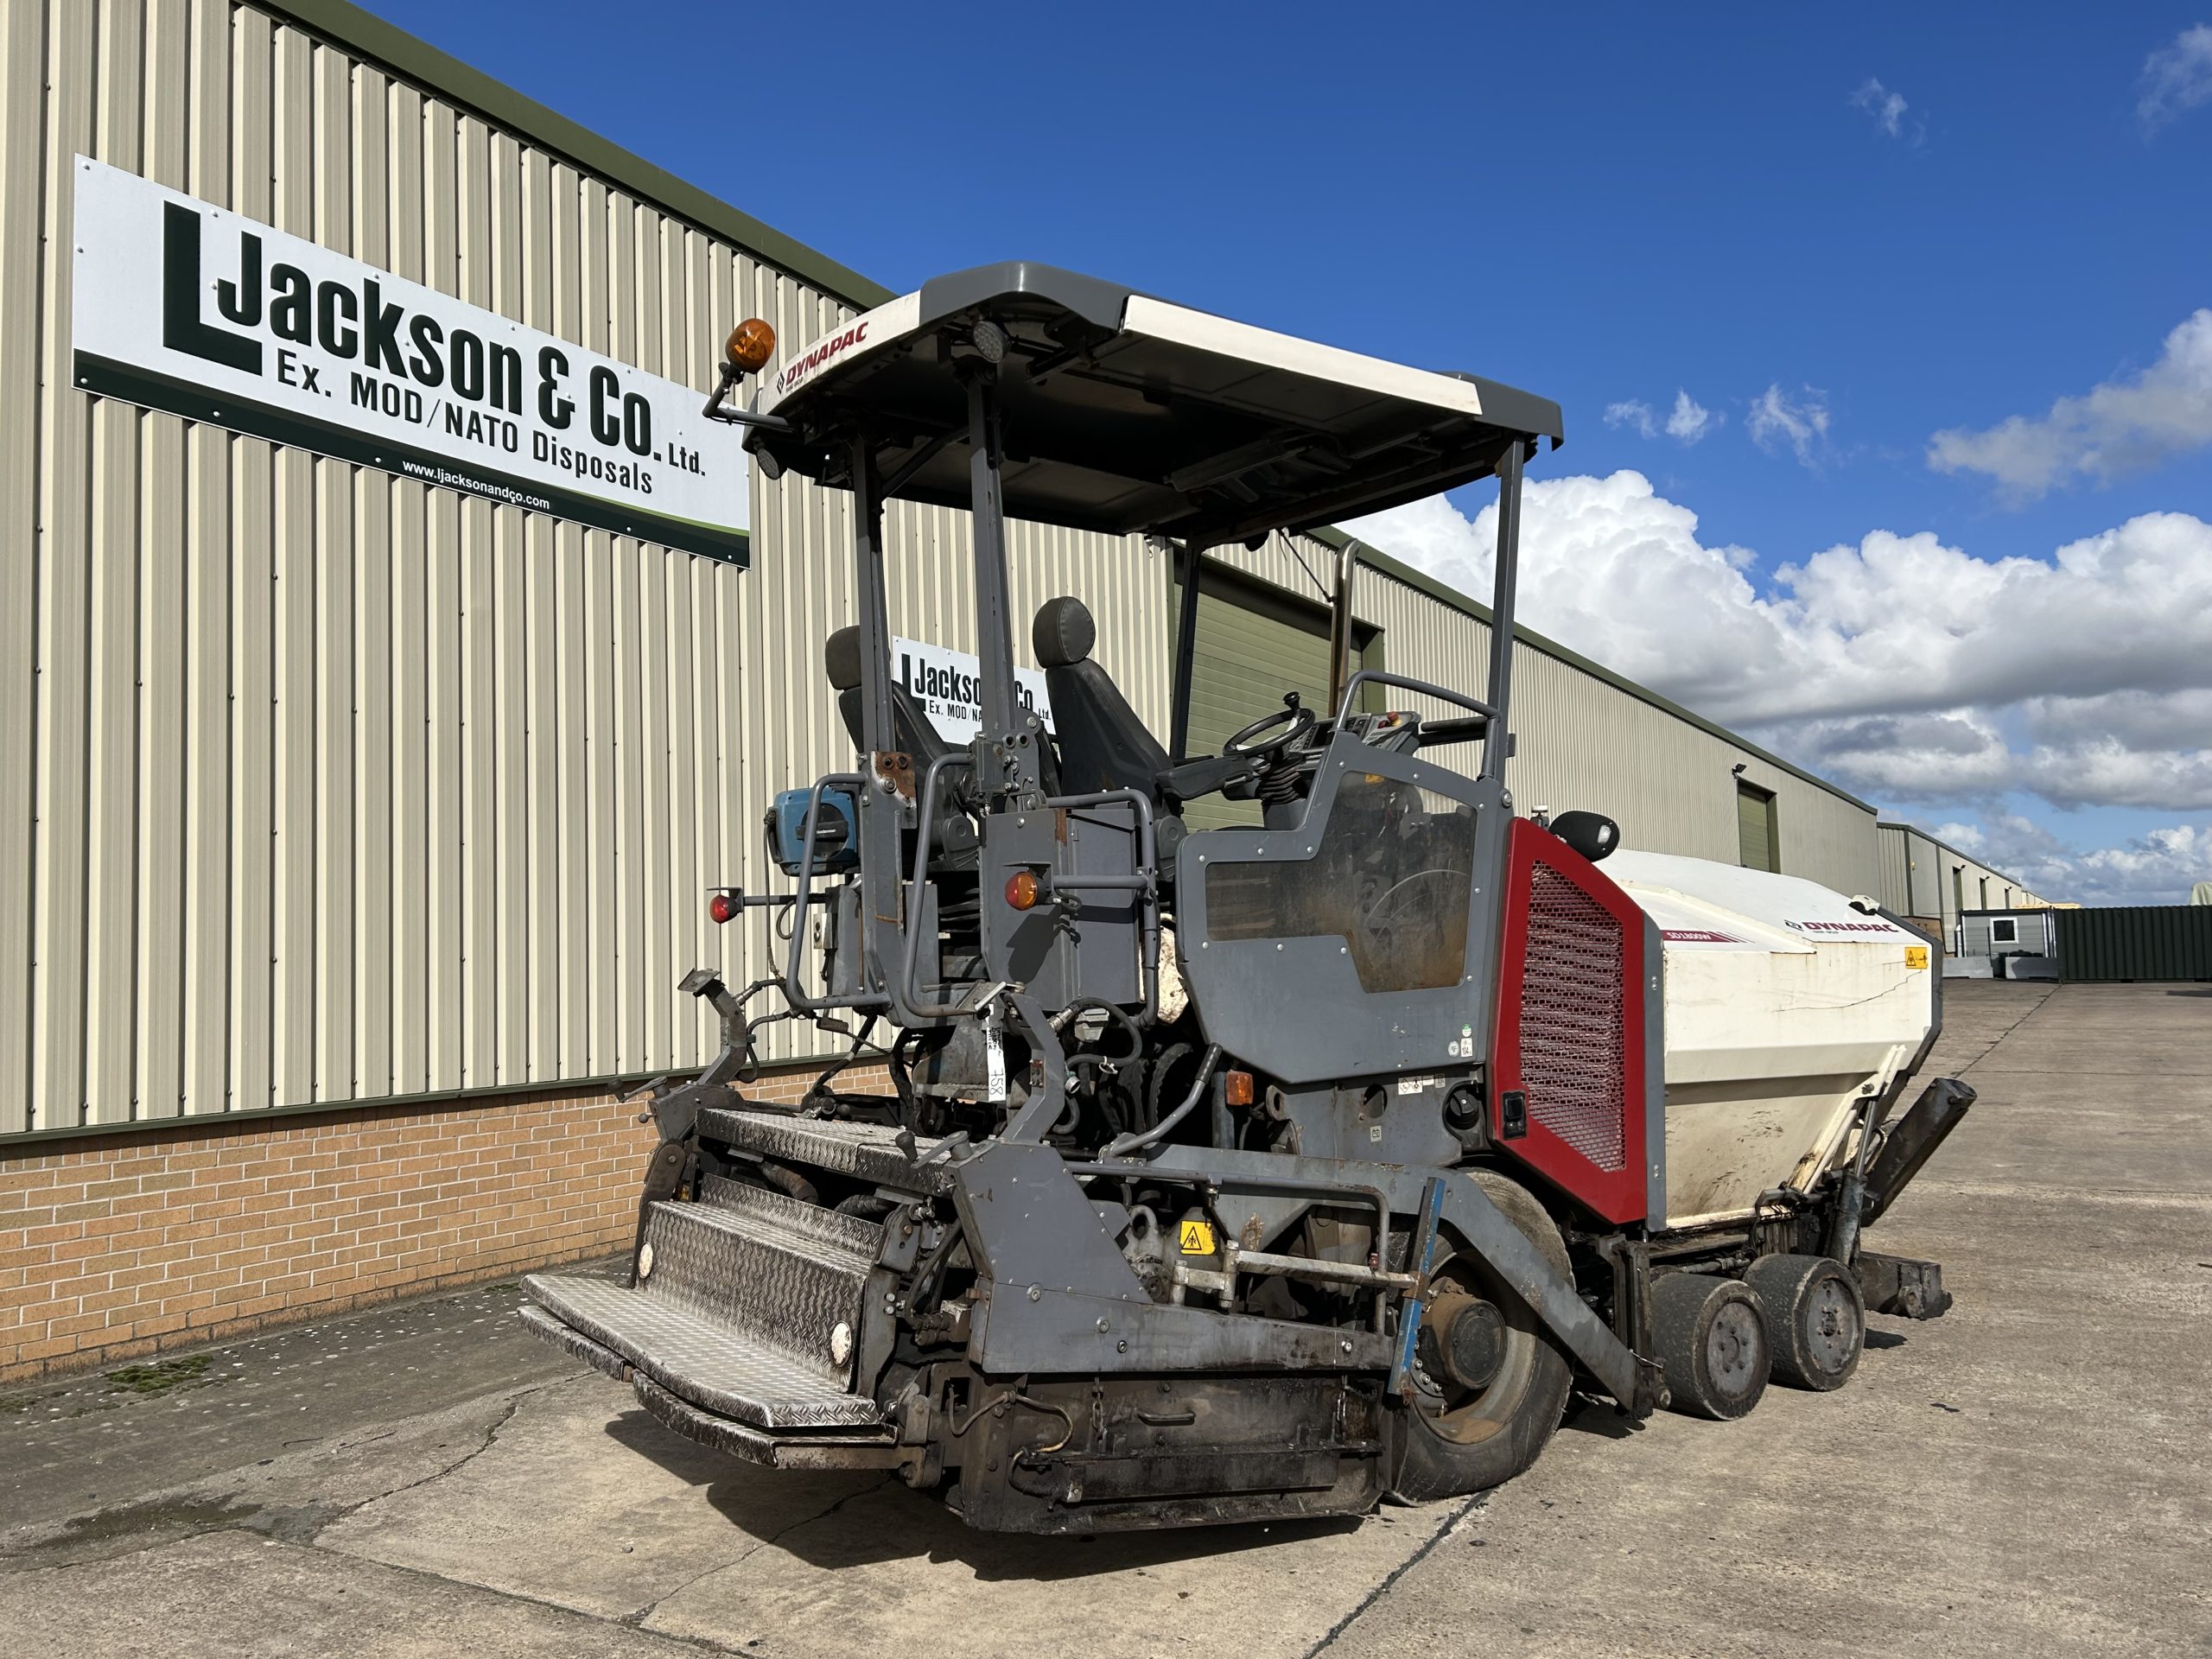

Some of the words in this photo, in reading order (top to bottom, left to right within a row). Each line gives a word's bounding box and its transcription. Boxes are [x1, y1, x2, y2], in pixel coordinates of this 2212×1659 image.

[786, 321, 868, 385] DYNAPAC
[277, 347, 332, 398] Ex.
[350, 371, 519, 453] MOD/NATO
[532, 429, 652, 495] Disposals
[538, 346, 575, 430] &
[589, 365, 662, 461] Co.
[669, 442, 706, 477] Ltd.
[402, 460, 550, 510] www.ljacksonandco.com
[929, 699, 944, 715] Ex.
[947, 702, 982, 722] MOD/NA
[1802, 922, 1899, 932] DYNAPAC
